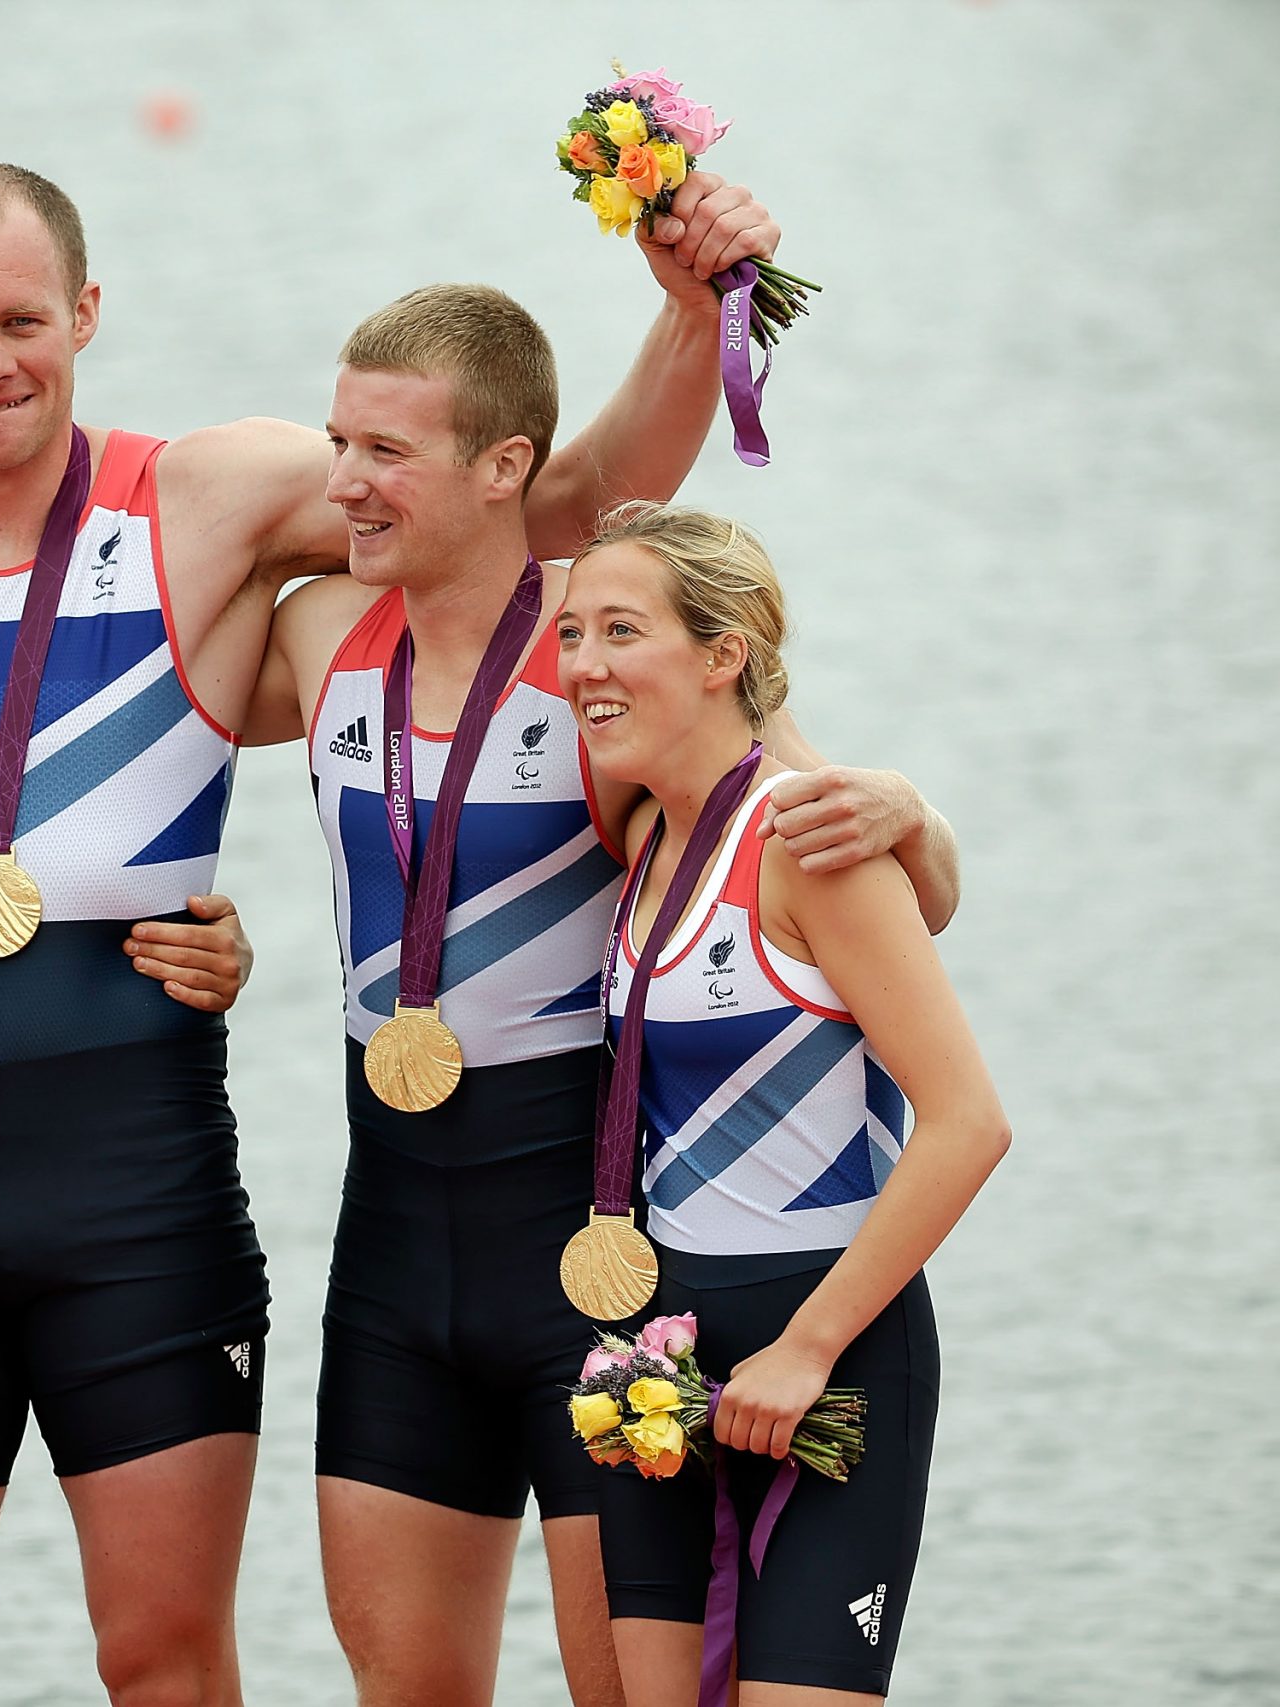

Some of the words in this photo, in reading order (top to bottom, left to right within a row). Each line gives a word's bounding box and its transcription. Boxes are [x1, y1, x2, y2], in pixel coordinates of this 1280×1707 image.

[727, 288, 745, 315] don
[727, 318, 743, 351] 2012
[328, 739, 373, 763] adidas
[389, 731, 405, 790] London
[393, 793, 409, 830] 2012
[869, 1583, 887, 1646] adidas
